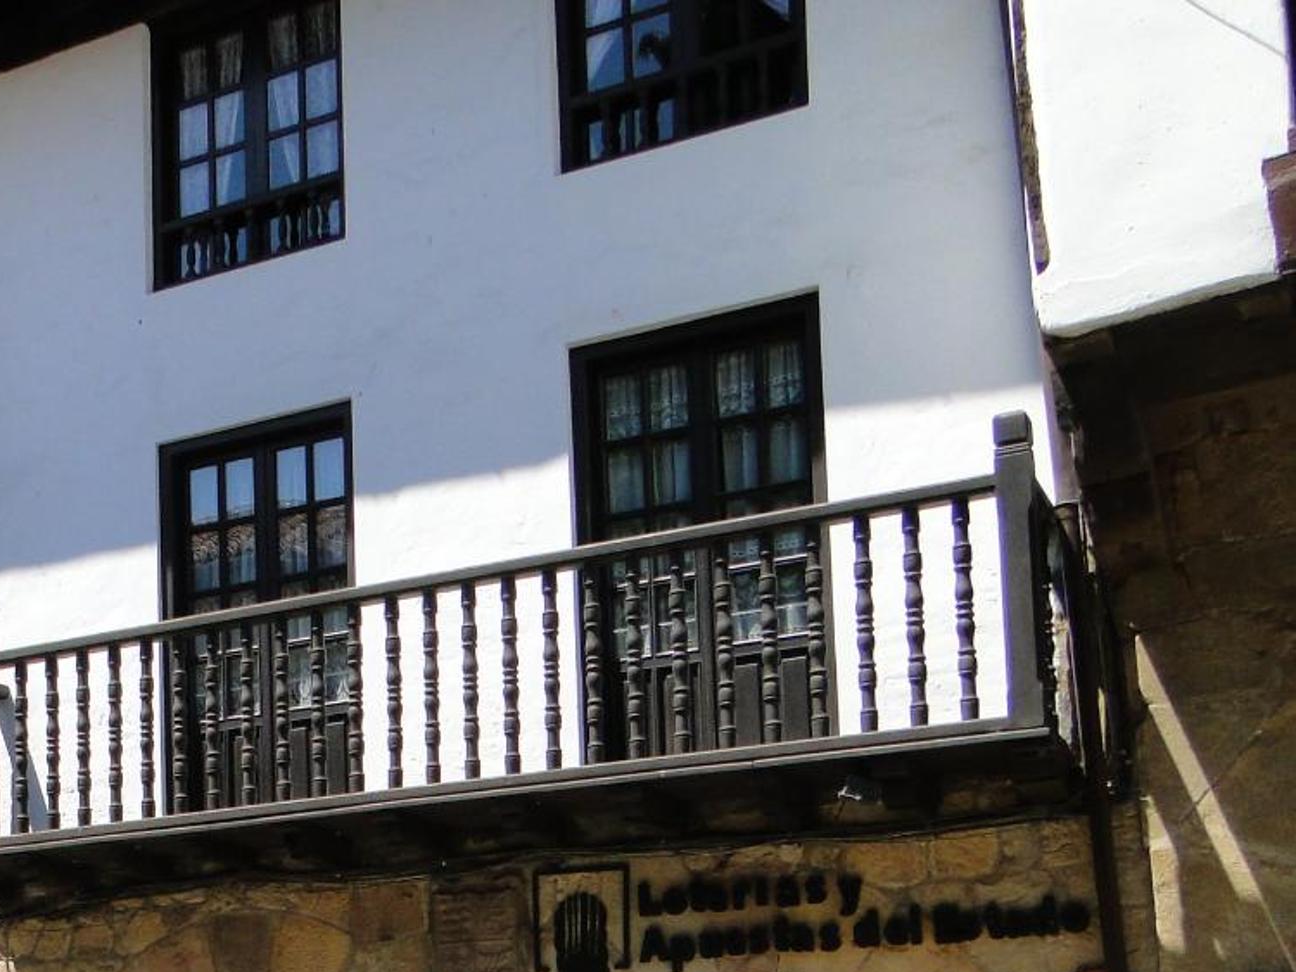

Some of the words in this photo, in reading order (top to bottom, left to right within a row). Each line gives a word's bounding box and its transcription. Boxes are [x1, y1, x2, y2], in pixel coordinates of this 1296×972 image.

[837, 873, 862, 916] y
[640, 911, 842, 970] Apuestas
[853, 903, 922, 947] del
[934, 895, 1090, 944] Estado
